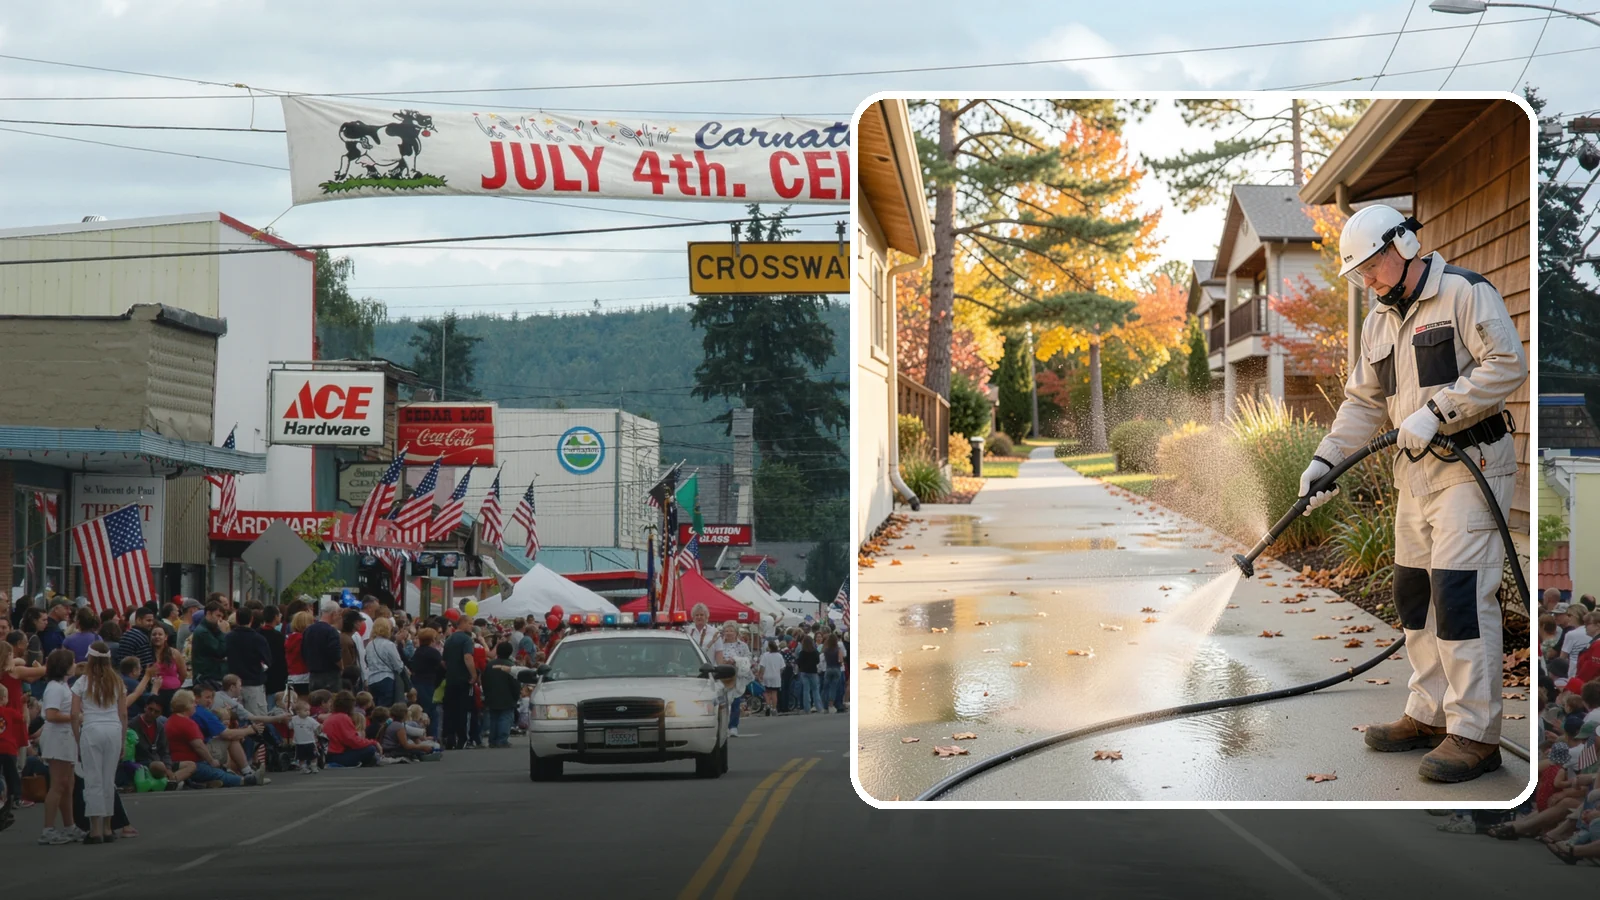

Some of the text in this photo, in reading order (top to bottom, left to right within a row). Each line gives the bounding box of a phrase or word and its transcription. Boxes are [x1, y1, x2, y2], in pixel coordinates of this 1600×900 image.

[481, 141, 605, 192] JULY
[632, 150, 746, 198] 4th.
[697, 254, 850, 279] CROSSWA
[283, 380, 373, 419] ACE
[406, 409, 453, 422] CEDAR
[283, 421, 371, 436] Hardware
[416, 428, 477, 447] Coca-Cola
[353, 467, 386, 479] Simpl
[96, 485, 124, 494] Vincent
[126, 486, 136, 494] de
[137, 486, 155, 495] Paul
[81, 503, 153, 521] THT
[688, 526, 741, 535] CRNATION
[699, 535, 730, 543] GLASS
